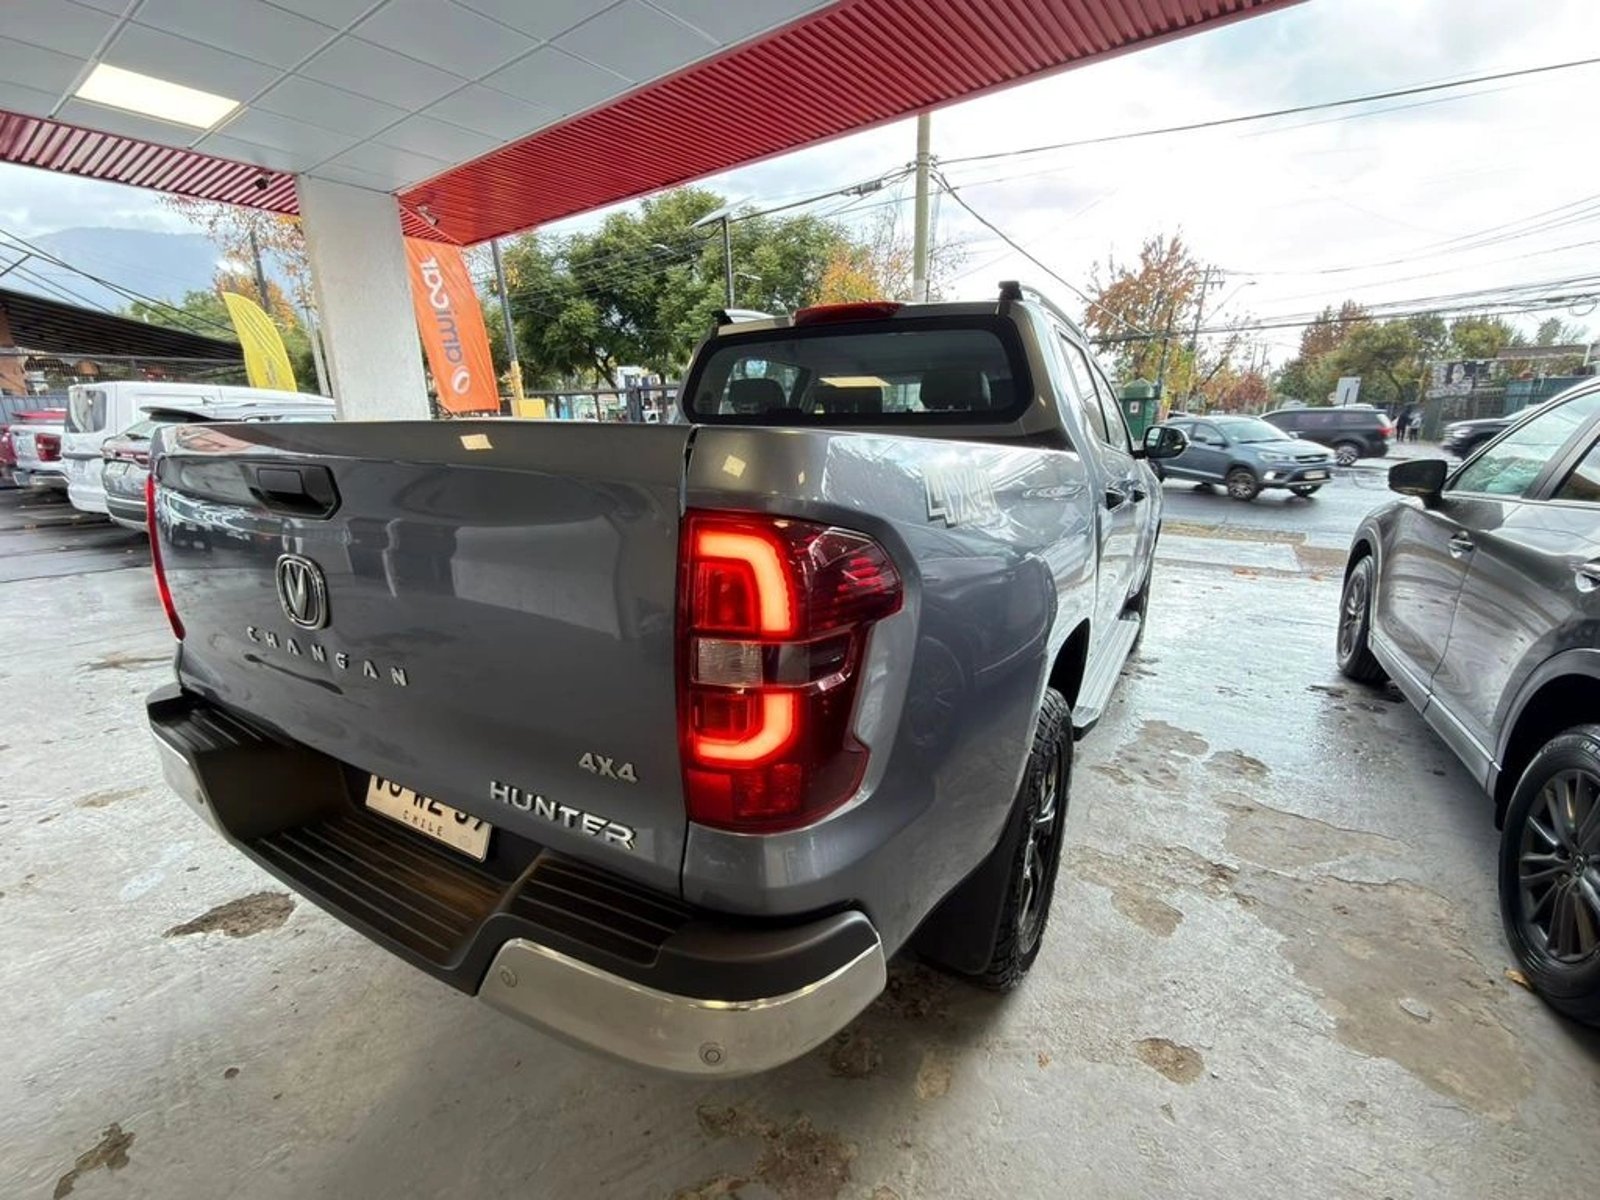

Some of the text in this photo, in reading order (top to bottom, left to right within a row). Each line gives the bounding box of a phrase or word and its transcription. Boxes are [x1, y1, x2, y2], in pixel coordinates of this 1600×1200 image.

[246, 626, 408, 687] CHANGAN
[578, 752, 638, 784] 4X4
[490, 781, 636, 850] HUNTER
